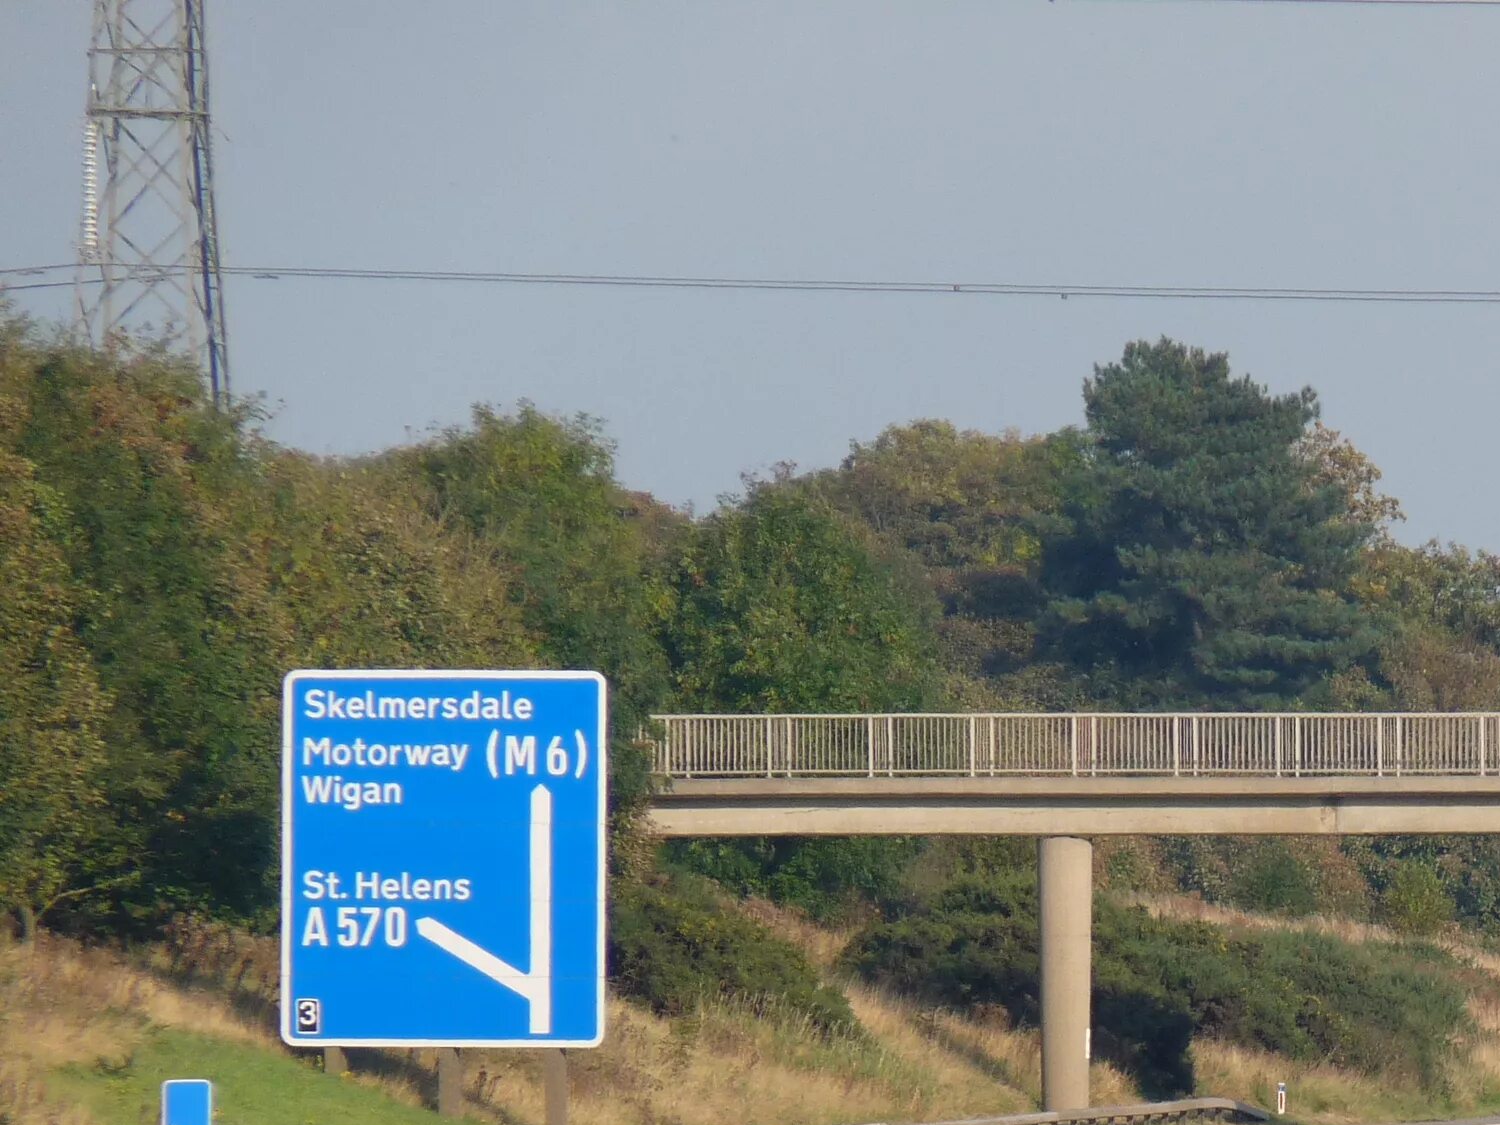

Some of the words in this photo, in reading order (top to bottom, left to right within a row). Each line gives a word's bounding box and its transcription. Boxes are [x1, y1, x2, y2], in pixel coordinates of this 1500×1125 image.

[304, 689, 533, 720] Skelmersdale
[302, 737, 469, 771] Motorway
[302, 776, 403, 810] Wigan
[302, 870, 347, 900] St.
[355, 872, 471, 900] Helens
[298, 1001, 318, 1025] 3
